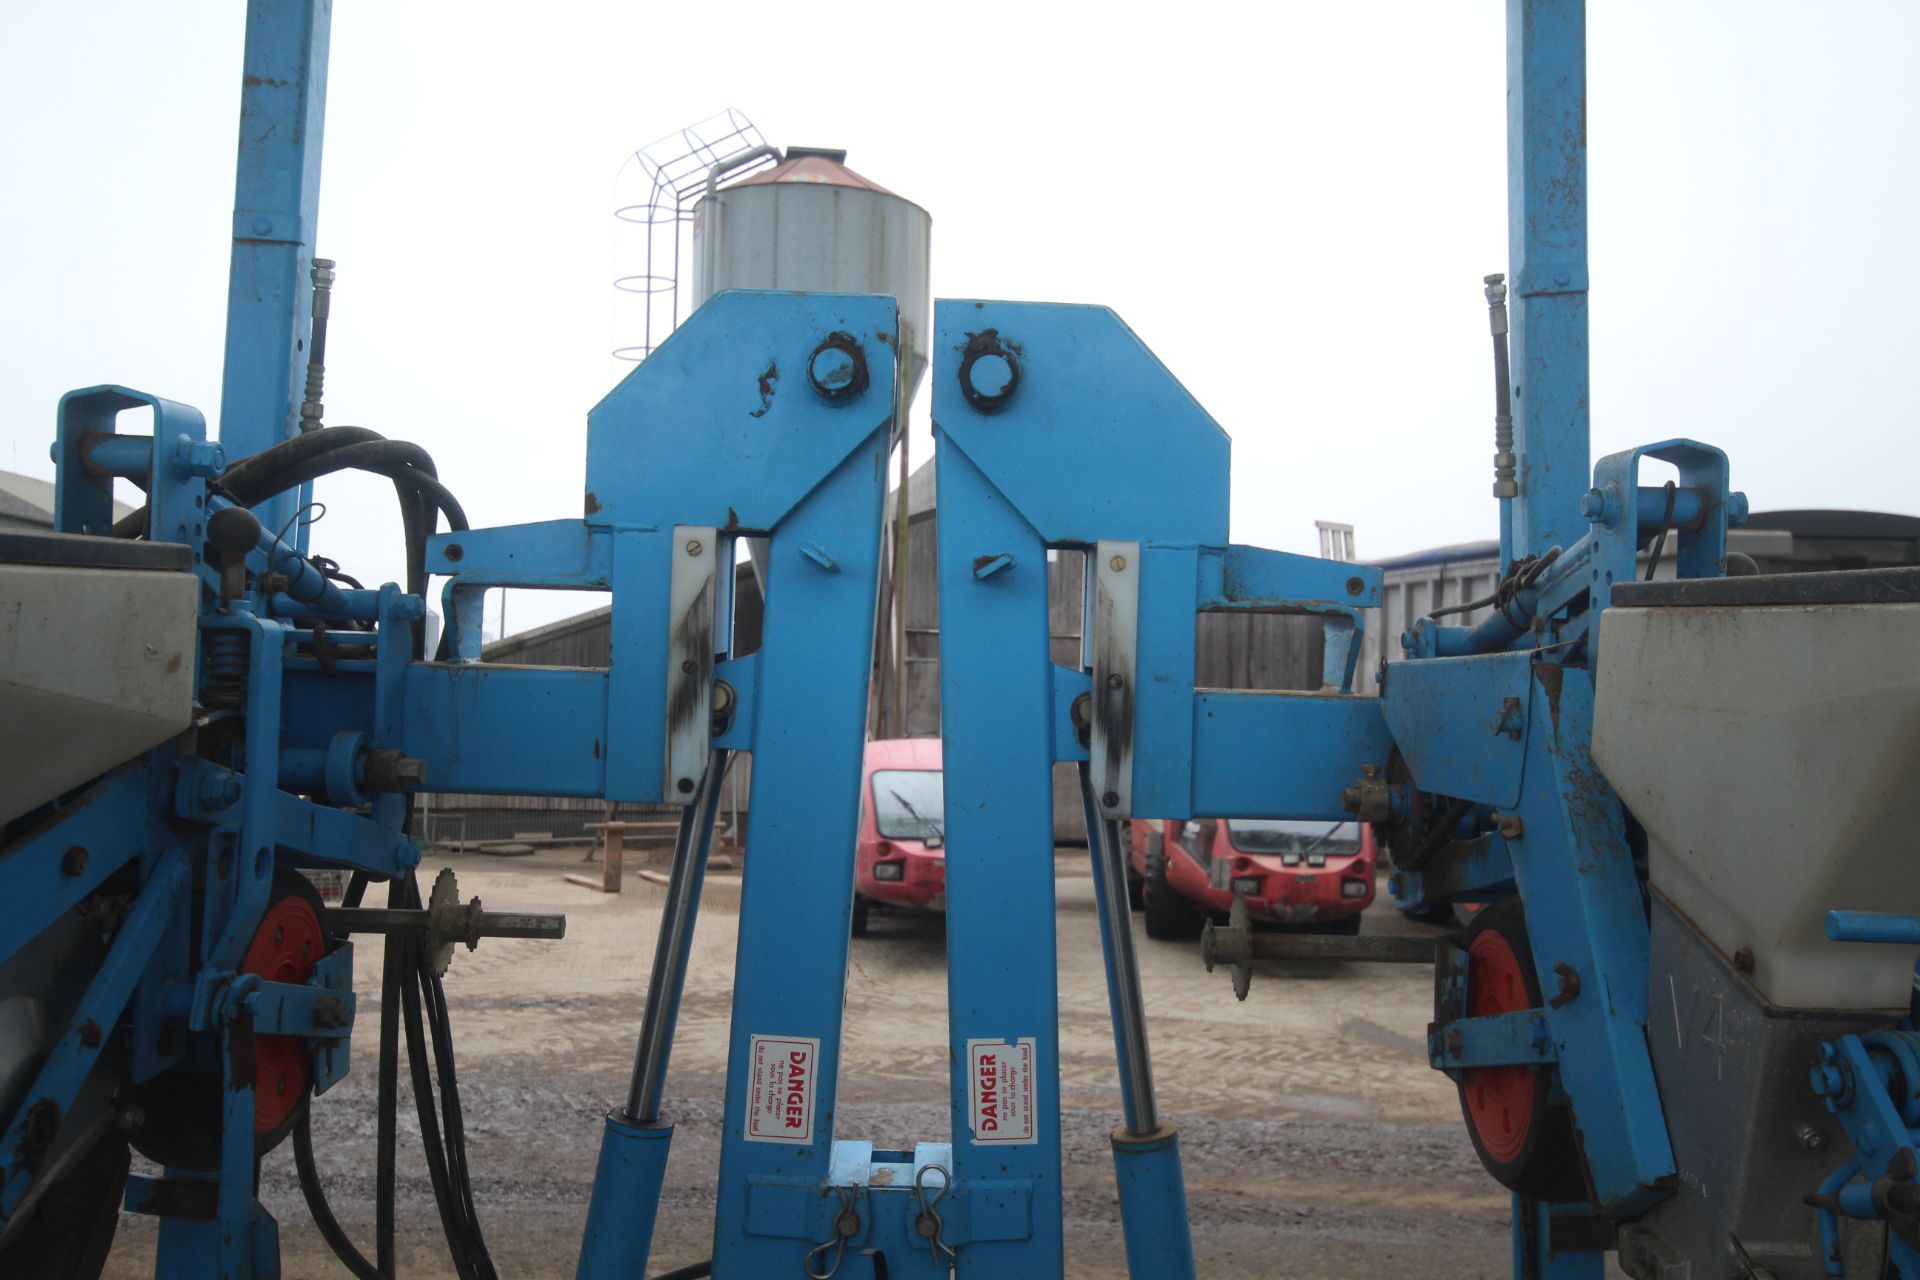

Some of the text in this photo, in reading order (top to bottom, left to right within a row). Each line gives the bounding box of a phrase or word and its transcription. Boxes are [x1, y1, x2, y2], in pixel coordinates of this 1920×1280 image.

[779, 1060, 784, 1068] ne
[1009, 1066, 1017, 1090] charge
[766, 1090, 776, 1113] charge
[786, 1052, 806, 1128] DANGER
[980, 1054, 997, 1131] DANGER
[1003, 1112, 1008, 1120] ne
